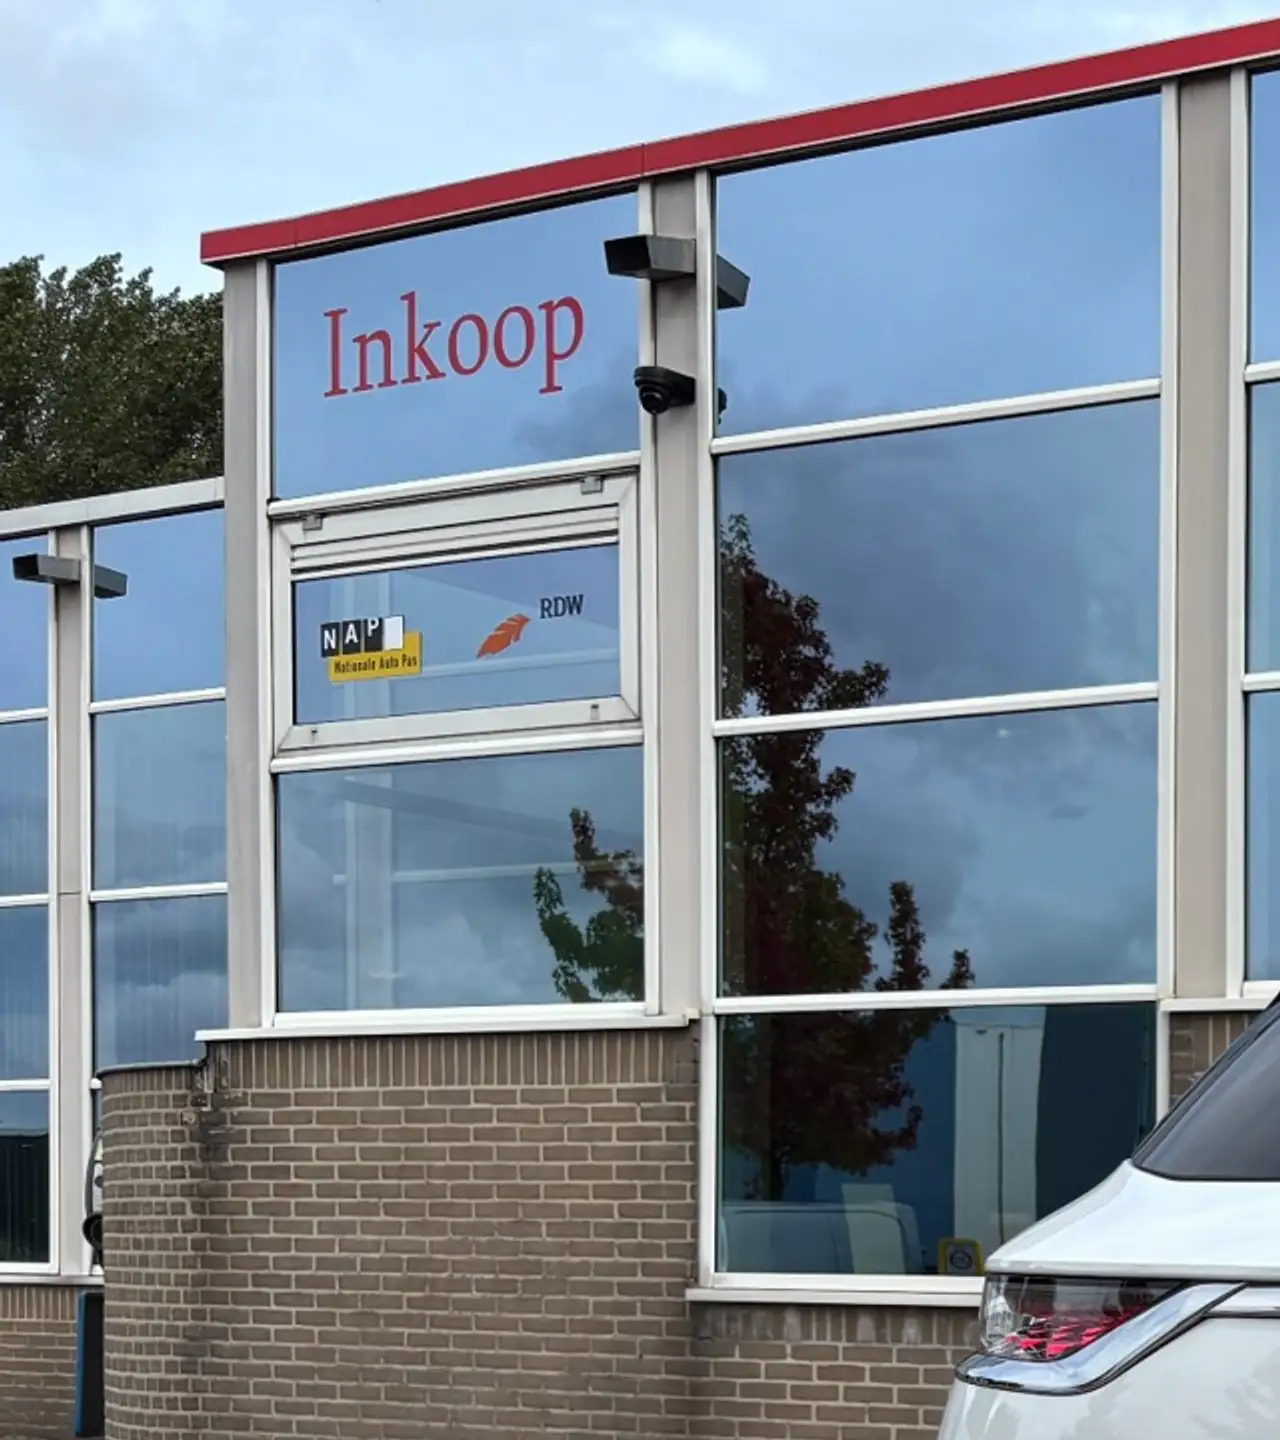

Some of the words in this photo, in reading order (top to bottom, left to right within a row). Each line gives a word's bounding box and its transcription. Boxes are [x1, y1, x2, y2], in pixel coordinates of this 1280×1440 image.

[323, 291, 585, 397] Inkoop
[539, 594, 585, 619] RDW
[323, 618, 380, 650] NAP
[334, 658, 376, 674] Nationale
[379, 656, 399, 670] Auto
[402, 653, 418, 667] Pas
